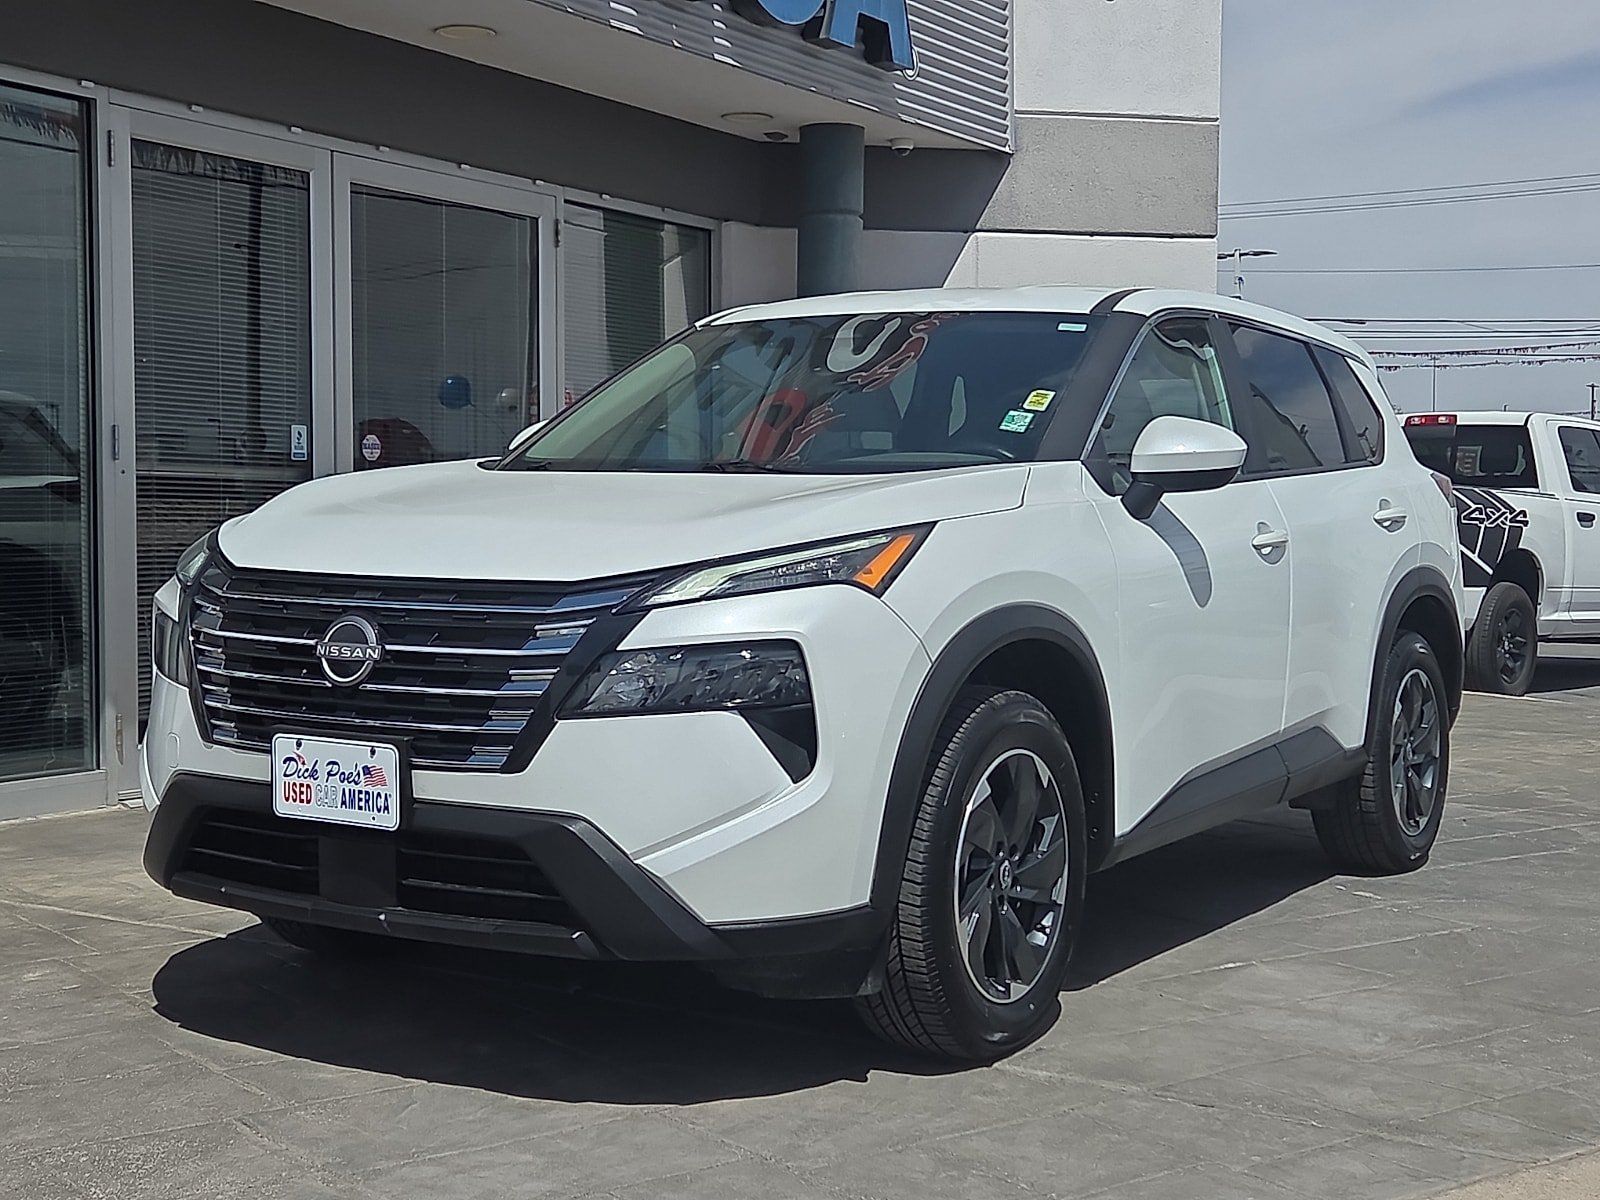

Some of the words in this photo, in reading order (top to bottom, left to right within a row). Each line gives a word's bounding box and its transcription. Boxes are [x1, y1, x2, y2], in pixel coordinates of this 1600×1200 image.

[317, 645, 379, 659] NISSAN
[282, 757, 320, 780] Dick
[325, 761, 362, 786] Poe's
[283, 781, 313, 805] USED
[315, 784, 339, 809] CAR
